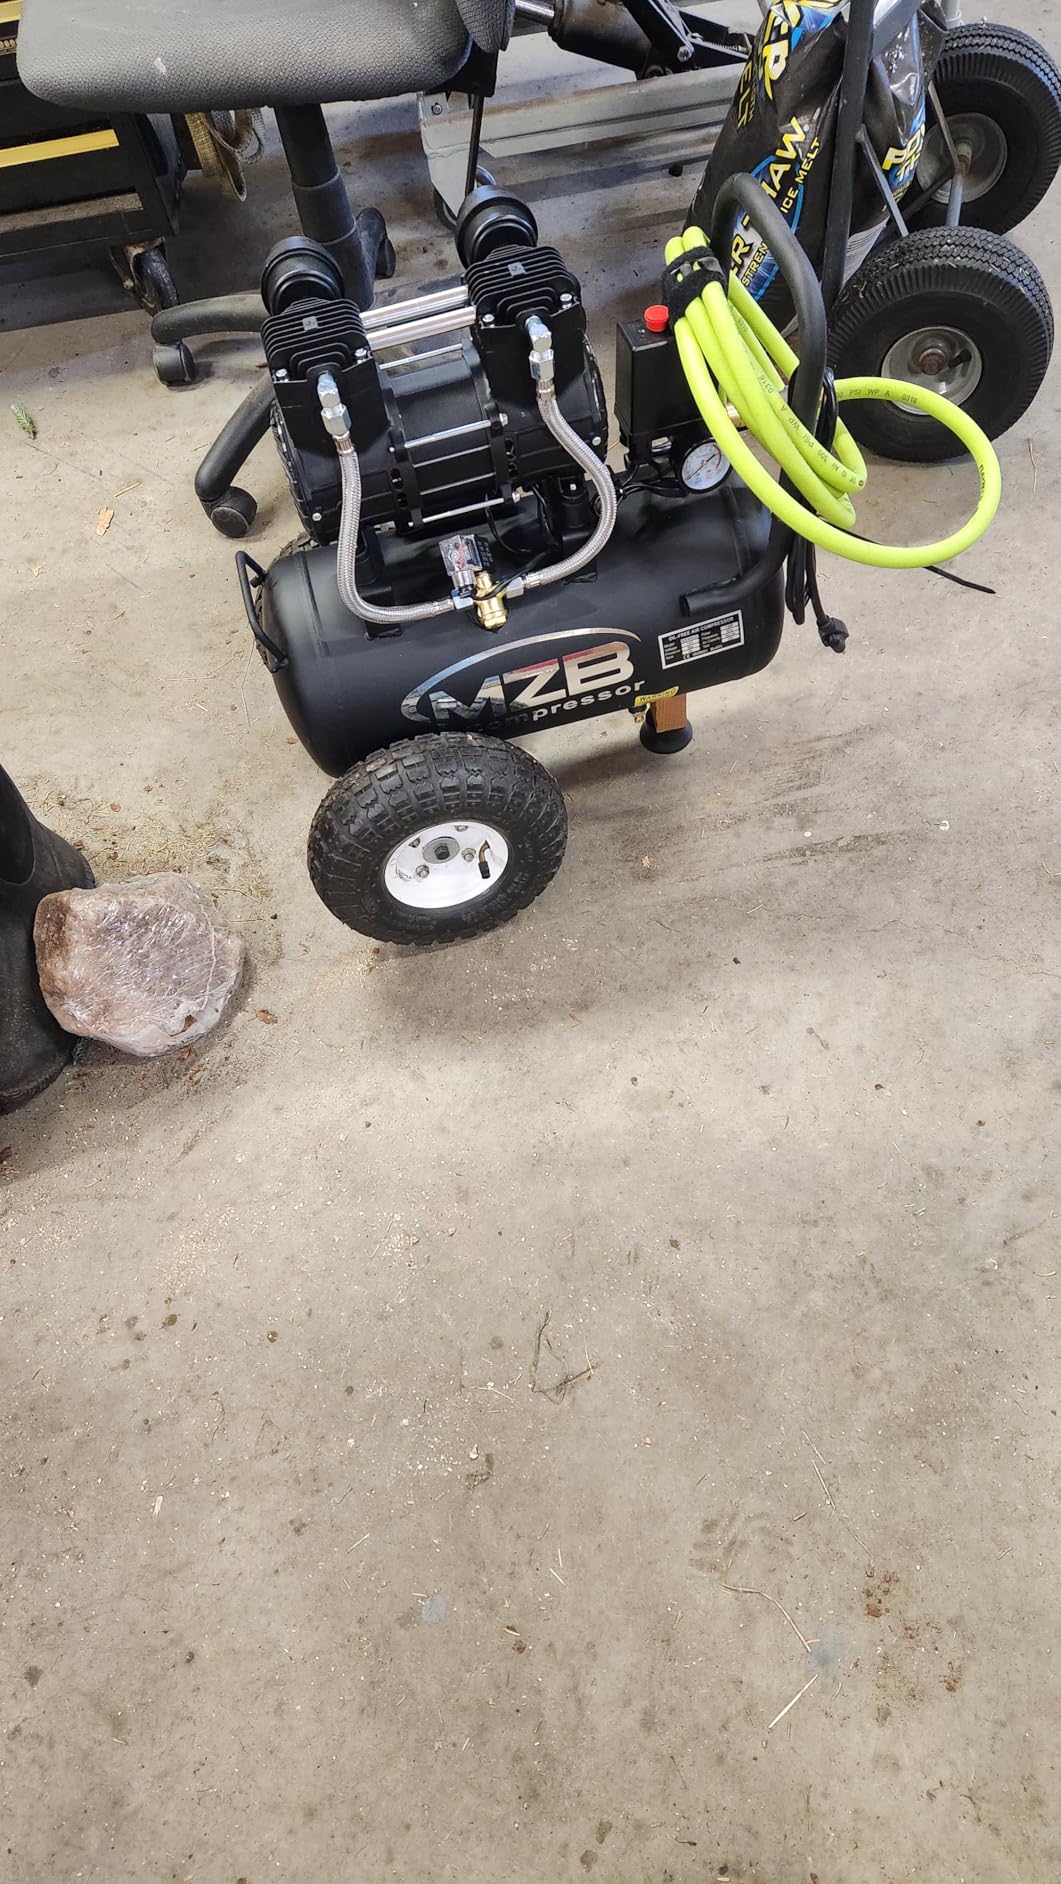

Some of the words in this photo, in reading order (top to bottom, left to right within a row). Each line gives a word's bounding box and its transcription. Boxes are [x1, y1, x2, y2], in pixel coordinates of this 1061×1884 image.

[780, 187, 799, 213] ICE
[795, 137, 820, 183] MELT
[902, 395, 918, 405] 0316
[429, 641, 635, 719] MZB
[640, 687, 677, 703] WARNING
